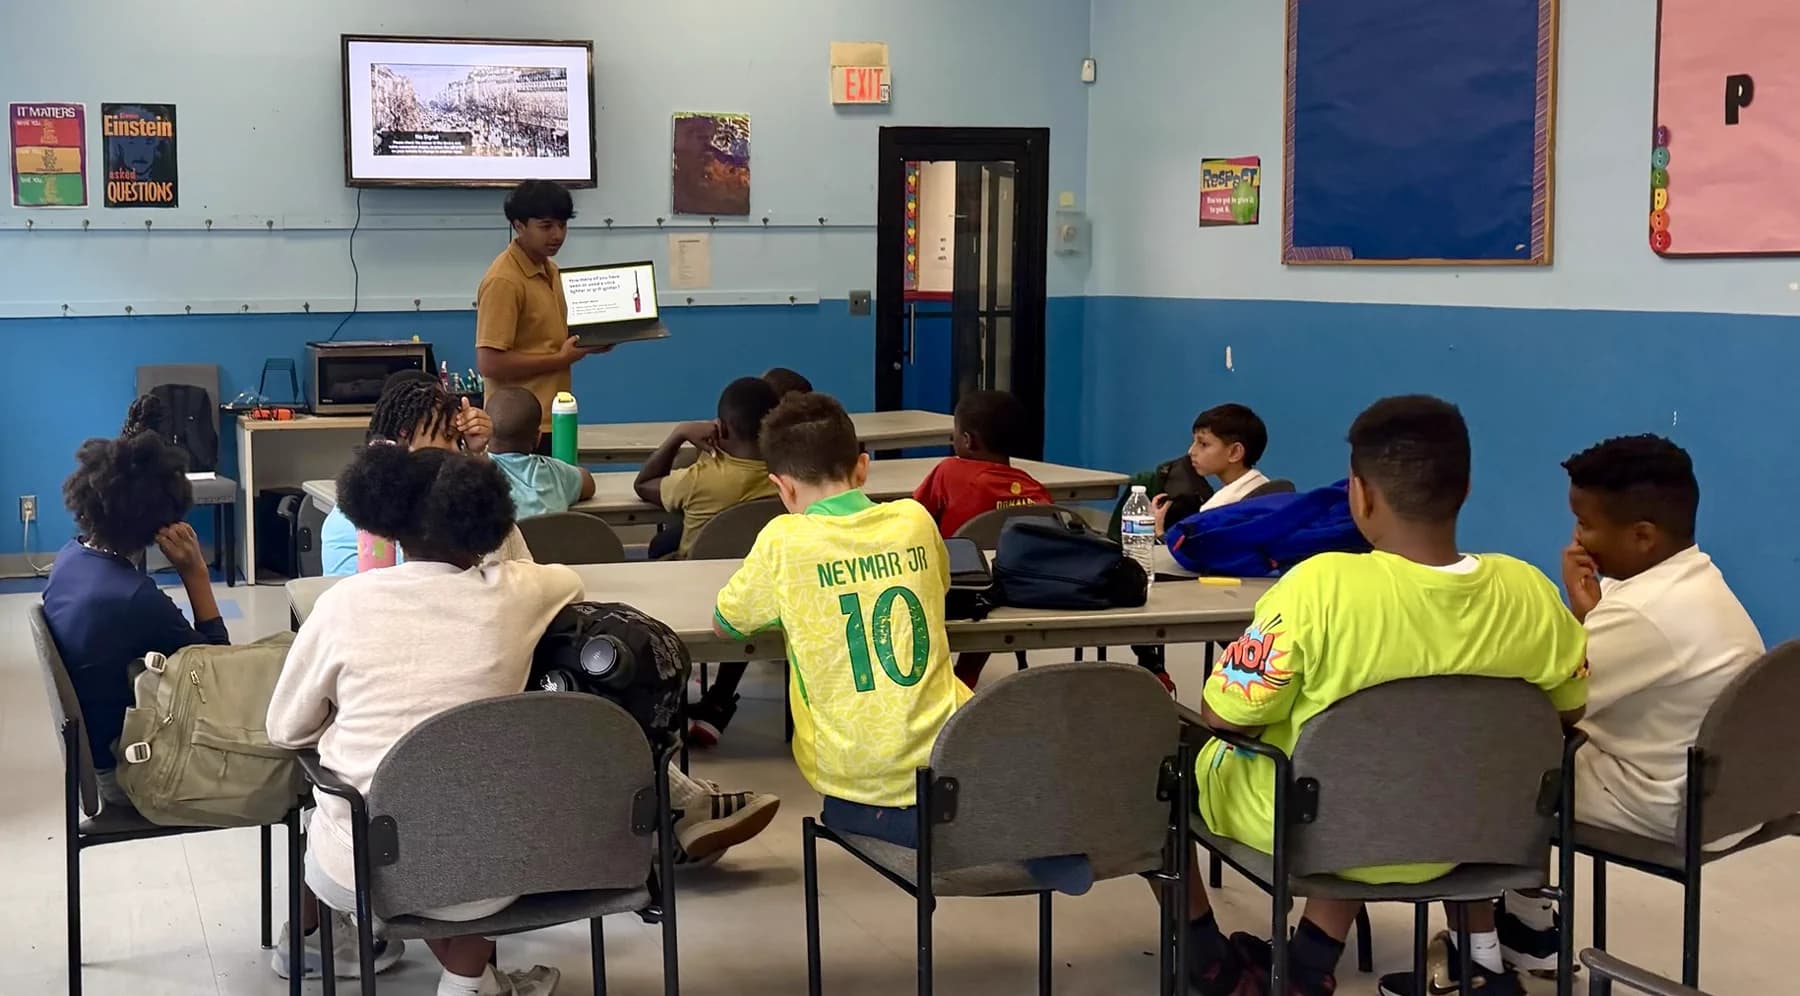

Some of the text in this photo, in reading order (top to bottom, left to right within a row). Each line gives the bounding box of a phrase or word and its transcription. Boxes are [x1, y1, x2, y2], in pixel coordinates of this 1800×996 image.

[846, 68, 884, 101] EXIT
[17, 106, 76, 119] IT MATTERS
[1725, 74, 1755, 126] P
[103, 114, 173, 137] Einstein
[109, 168, 136, 179] asked
[108, 181, 173, 203] QUESTIONS
[817, 546, 928, 588] NEYMAR JR
[839, 586, 930, 692] 10
